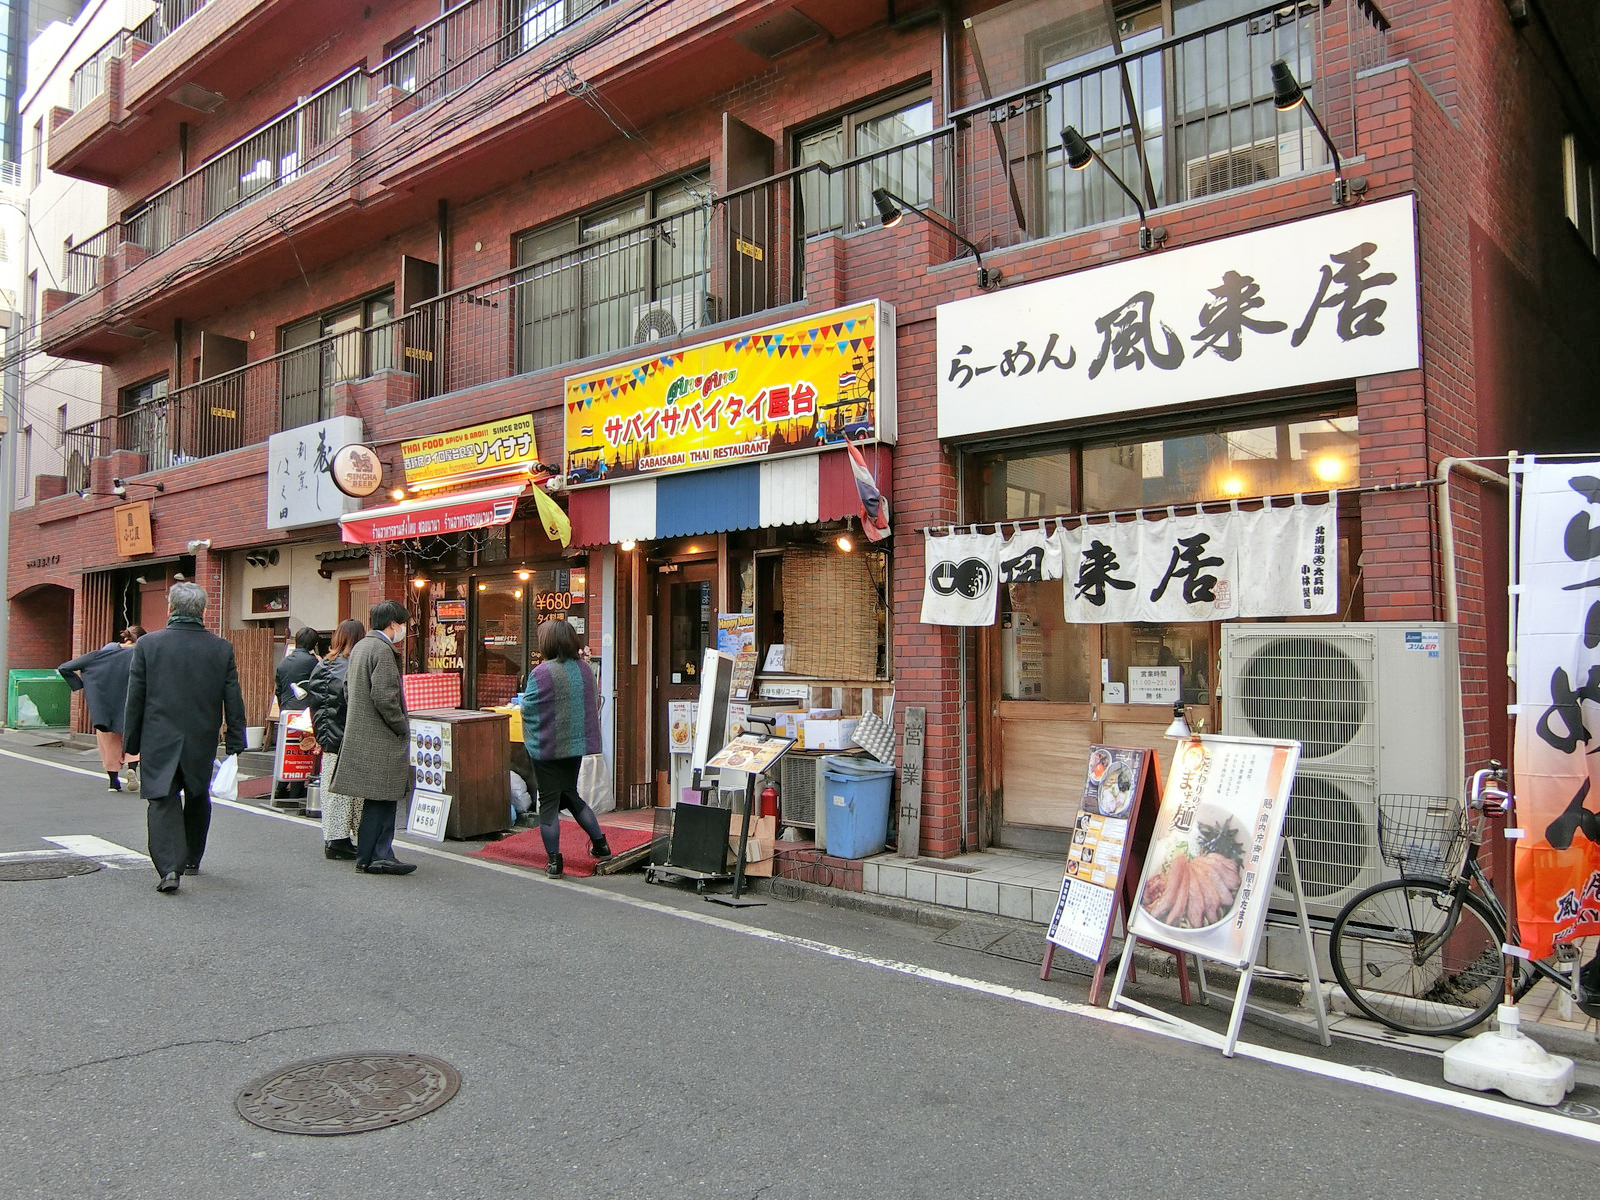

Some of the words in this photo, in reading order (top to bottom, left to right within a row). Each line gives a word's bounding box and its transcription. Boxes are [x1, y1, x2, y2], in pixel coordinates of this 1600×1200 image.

[948, 333, 1076, 389] らーめん
[1087, 241, 1398, 380] 風来居
[605, 384, 815, 444] サバイサバイタイ屋台
[402, 445, 420, 455] THAI
[422, 438, 444, 451] FOOD
[445, 435, 464, 444] SPICY
[493, 424, 512, 435] SINCE
[513, 421, 530, 431] 2010
[474, 432, 532, 464] ソイナナ
[640, 453, 685, 469] SABAISABAI
[690, 450, 709, 461] THAI
[713, 441, 769, 459] RESTAURANT
[347, 472, 377, 481] SINGHA
[536, 592, 572, 610] ¥680
[719, 618, 738, 632] Happy
[738, 615, 754, 627] Hour
[428, 657, 464, 669] SINGHA
[1140, 670, 1167, 678] 営業時間
[760, 686, 806, 697] お持ち帰りコーナー
[901, 724, 922, 825] 営業中
[417, 803, 440, 816] お持ち帰り
